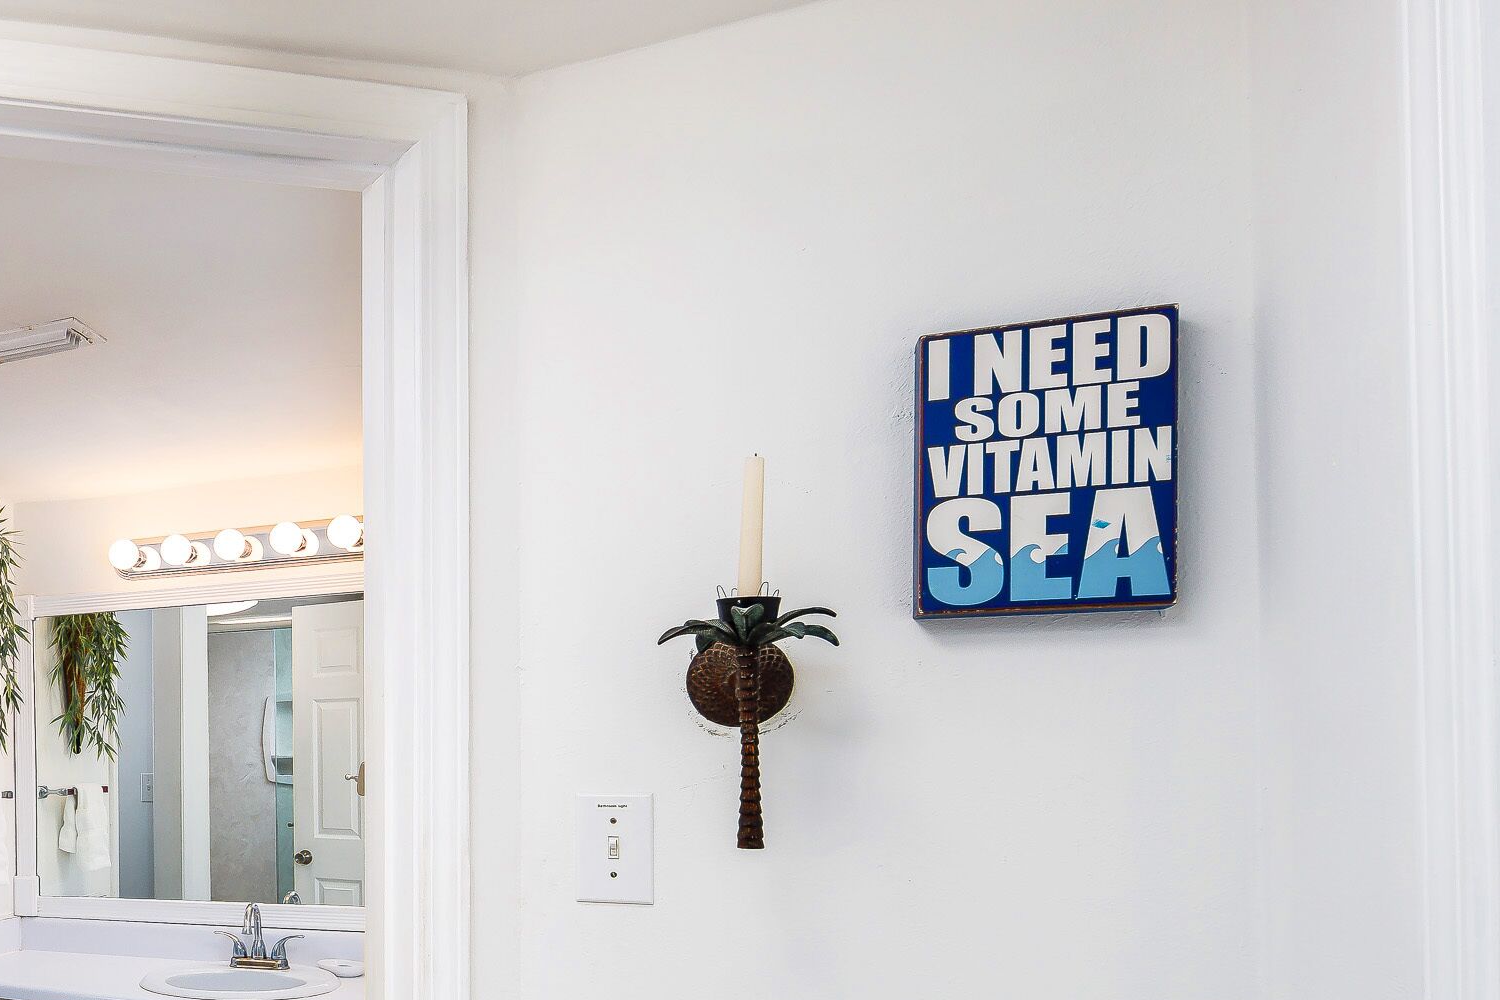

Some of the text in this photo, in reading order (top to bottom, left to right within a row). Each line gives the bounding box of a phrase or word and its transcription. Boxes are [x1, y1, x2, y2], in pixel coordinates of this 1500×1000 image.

[928, 313, 1171, 401] I NEED
[954, 381, 1140, 442] SOME
[927, 425, 1172, 498] VITAMIN
[926, 485, 1171, 606] SEA
